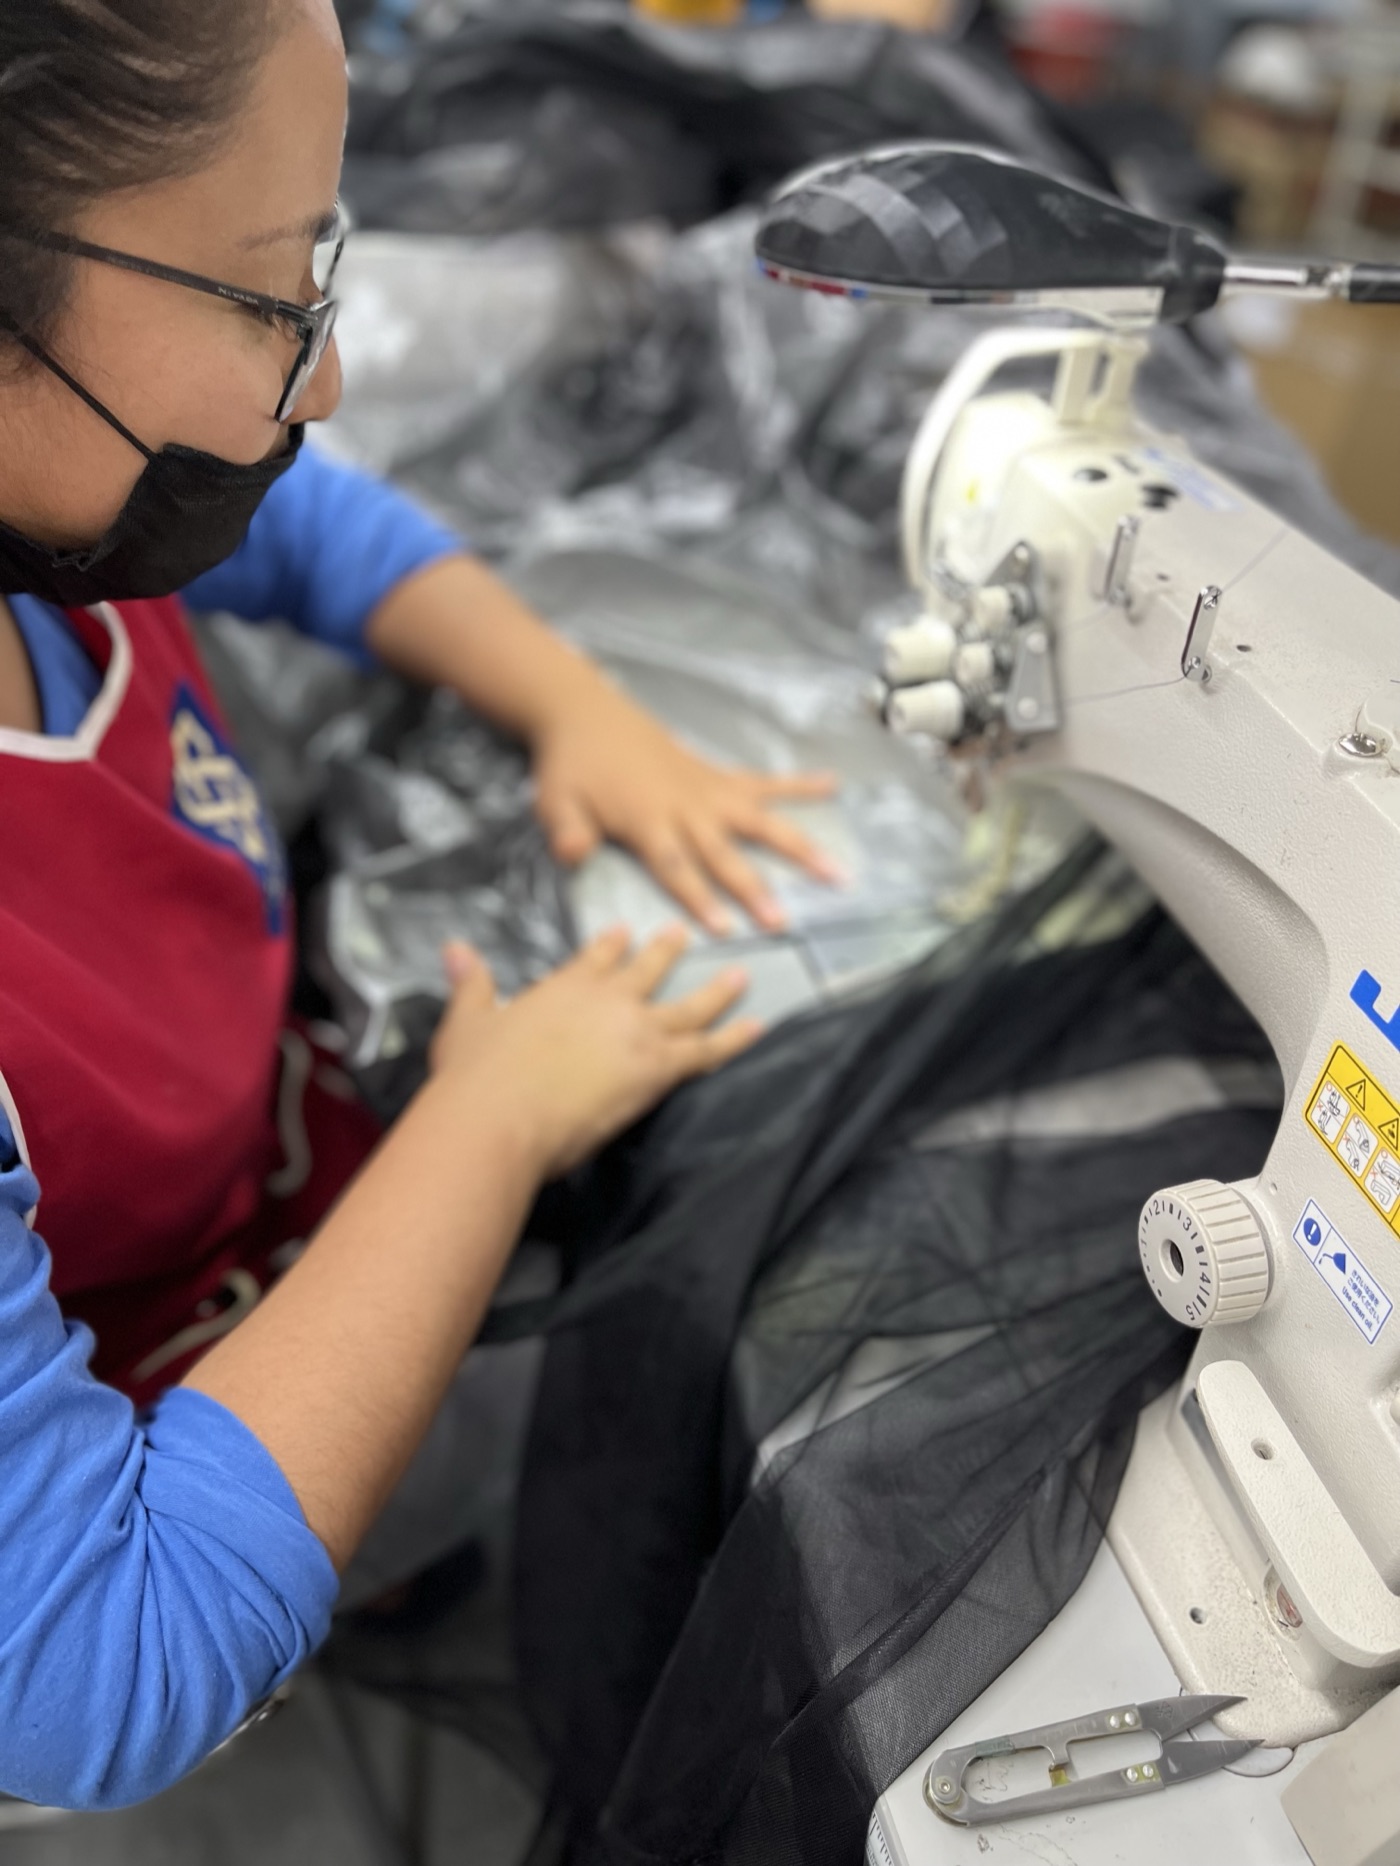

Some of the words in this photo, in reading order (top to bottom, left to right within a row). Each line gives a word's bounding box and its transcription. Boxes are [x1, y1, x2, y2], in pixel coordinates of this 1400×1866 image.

[1153, 1199, 1161, 1216] 2
[1183, 1216, 1192, 1231] 3
[1199, 1271, 1211, 1284] 4
[1342, 1286, 1352, 1302] Use
[1352, 1300, 1365, 1320] clean
[1185, 1304, 1195, 1321] 5
